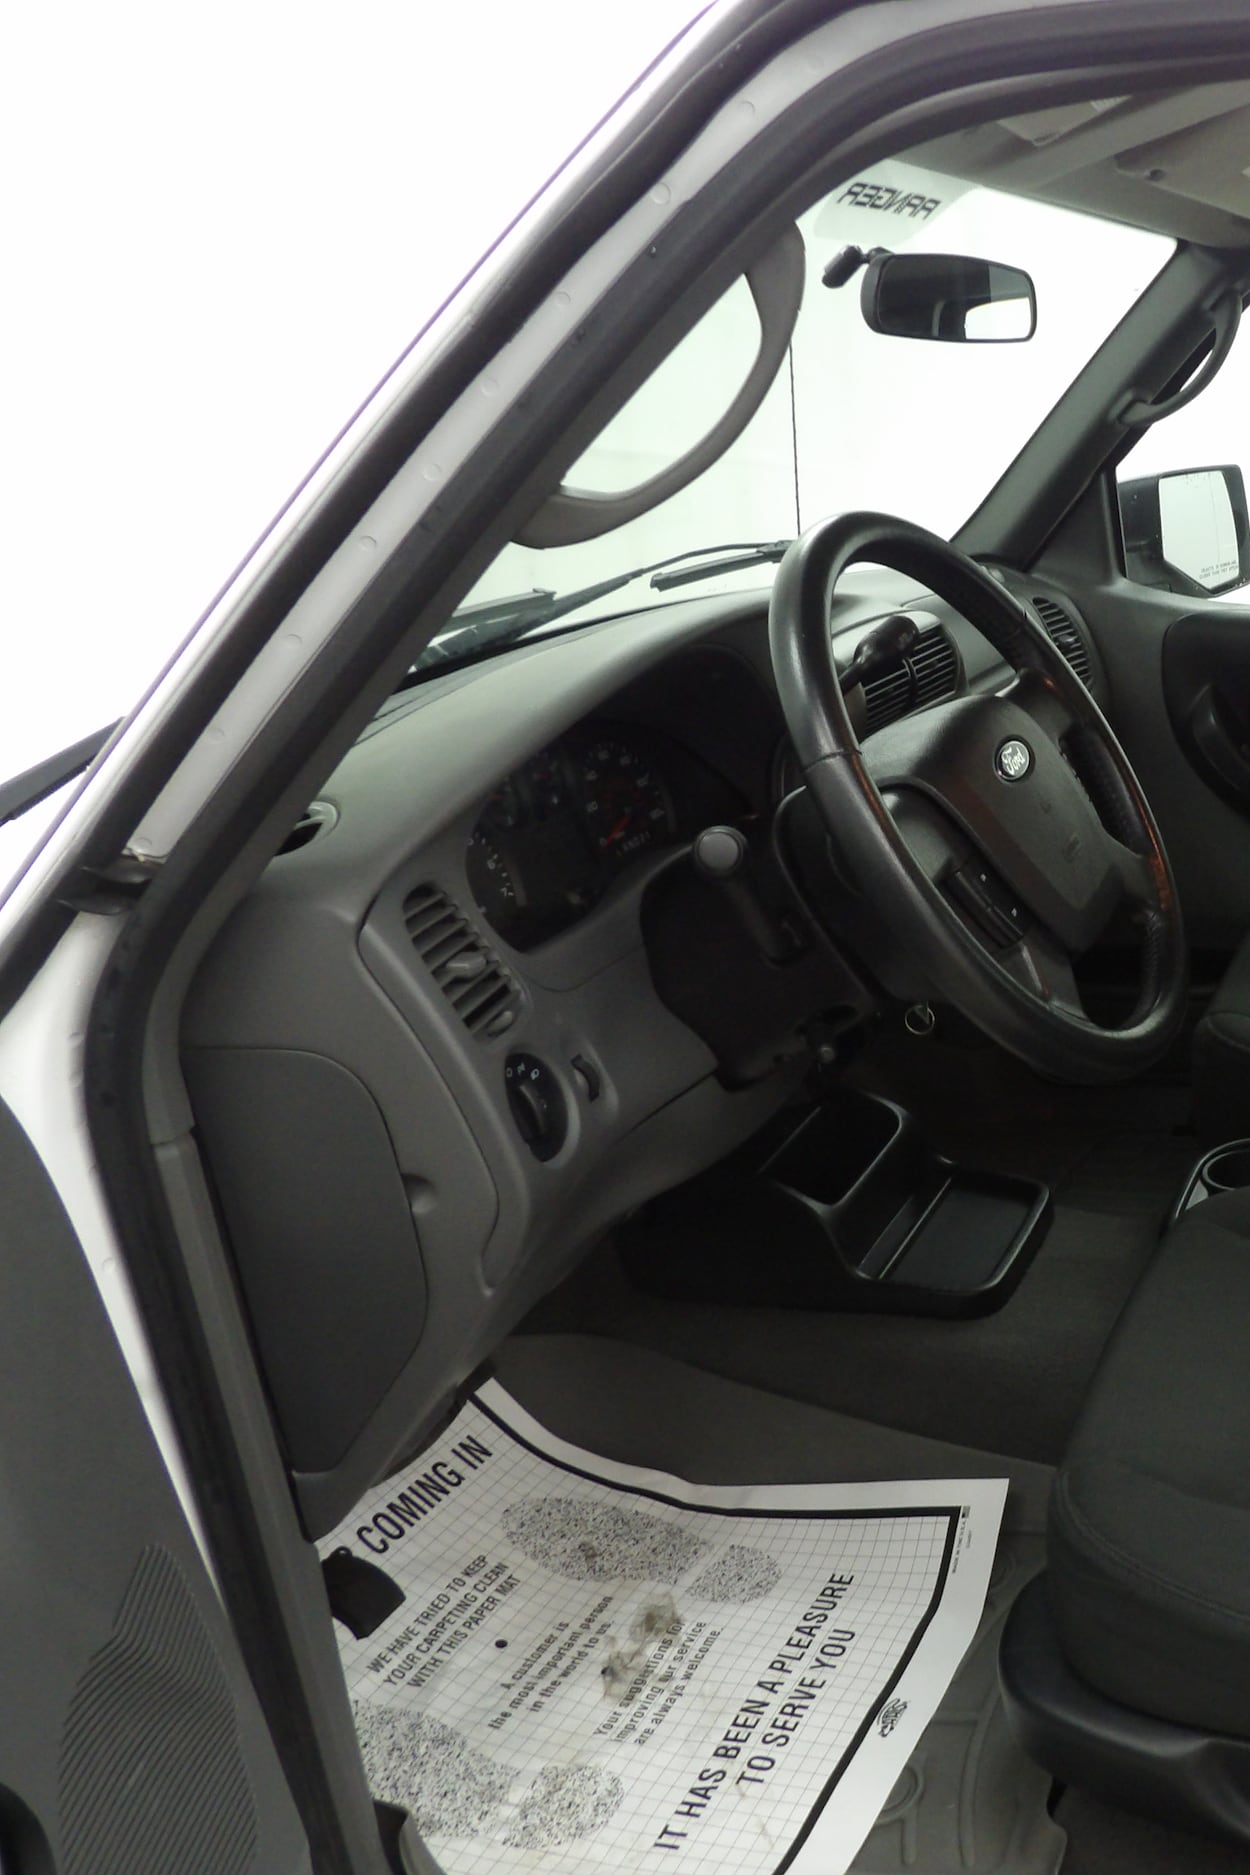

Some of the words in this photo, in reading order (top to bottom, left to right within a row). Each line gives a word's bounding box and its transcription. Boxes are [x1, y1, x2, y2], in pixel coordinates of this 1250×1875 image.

[1001, 746, 1026, 776] Ford
[356, 1461, 466, 1554] COMING
[451, 1434, 493, 1470] IN
[366, 1650, 393, 1674] WE
[386, 1626, 420, 1656] HAVE
[414, 1592, 451, 1627] TRIED
[445, 1577, 466, 1593] TO
[461, 1554, 489, 1578] KEEP
[384, 1652, 422, 1687] YOUR
[415, 1591, 478, 1654] CARPETING
[473, 1562, 510, 1593] CLEAN
[407, 1656, 445, 1689] WITH
[436, 1631, 468, 1657] THIS
[462, 1595, 501, 1632] PAPER
[495, 1574, 521, 1597] MAT
[487, 1711, 513, 1731] the
[509, 1680, 538, 1711] most
[536, 1629, 582, 1681] important
[579, 1595, 614, 1630] person
[500, 1682, 515, 1691] A
[511, 1634, 559, 1681] customer
[555, 1620, 570, 1633] is
[768, 1572, 855, 1675] PLEASURE
[529, 1699, 544, 1713] in
[542, 1678, 562, 1699] the
[560, 1649, 590, 1681] world
[584, 1637, 600, 1650] to
[592, 1707, 623, 1737] Your
[621, 1635, 674, 1709] suggestions
[666, 1620, 686, 1638] for
[613, 1682, 665, 1743] improving
[672, 1621, 708, 1664] service
[633, 1726, 655, 1746] are
[650, 1684, 686, 1726] always
[680, 1627, 725, 1682] welcome.
[712, 1698, 772, 1760] BEEN
[735, 1755, 777, 1786] TO
[760, 1676, 828, 1748] SERVE
[809, 1628, 857, 1672] YOU
[756, 1678, 786, 1695] A
[652, 1823, 689, 1850] IT
[673, 1767, 728, 1819] HAS
